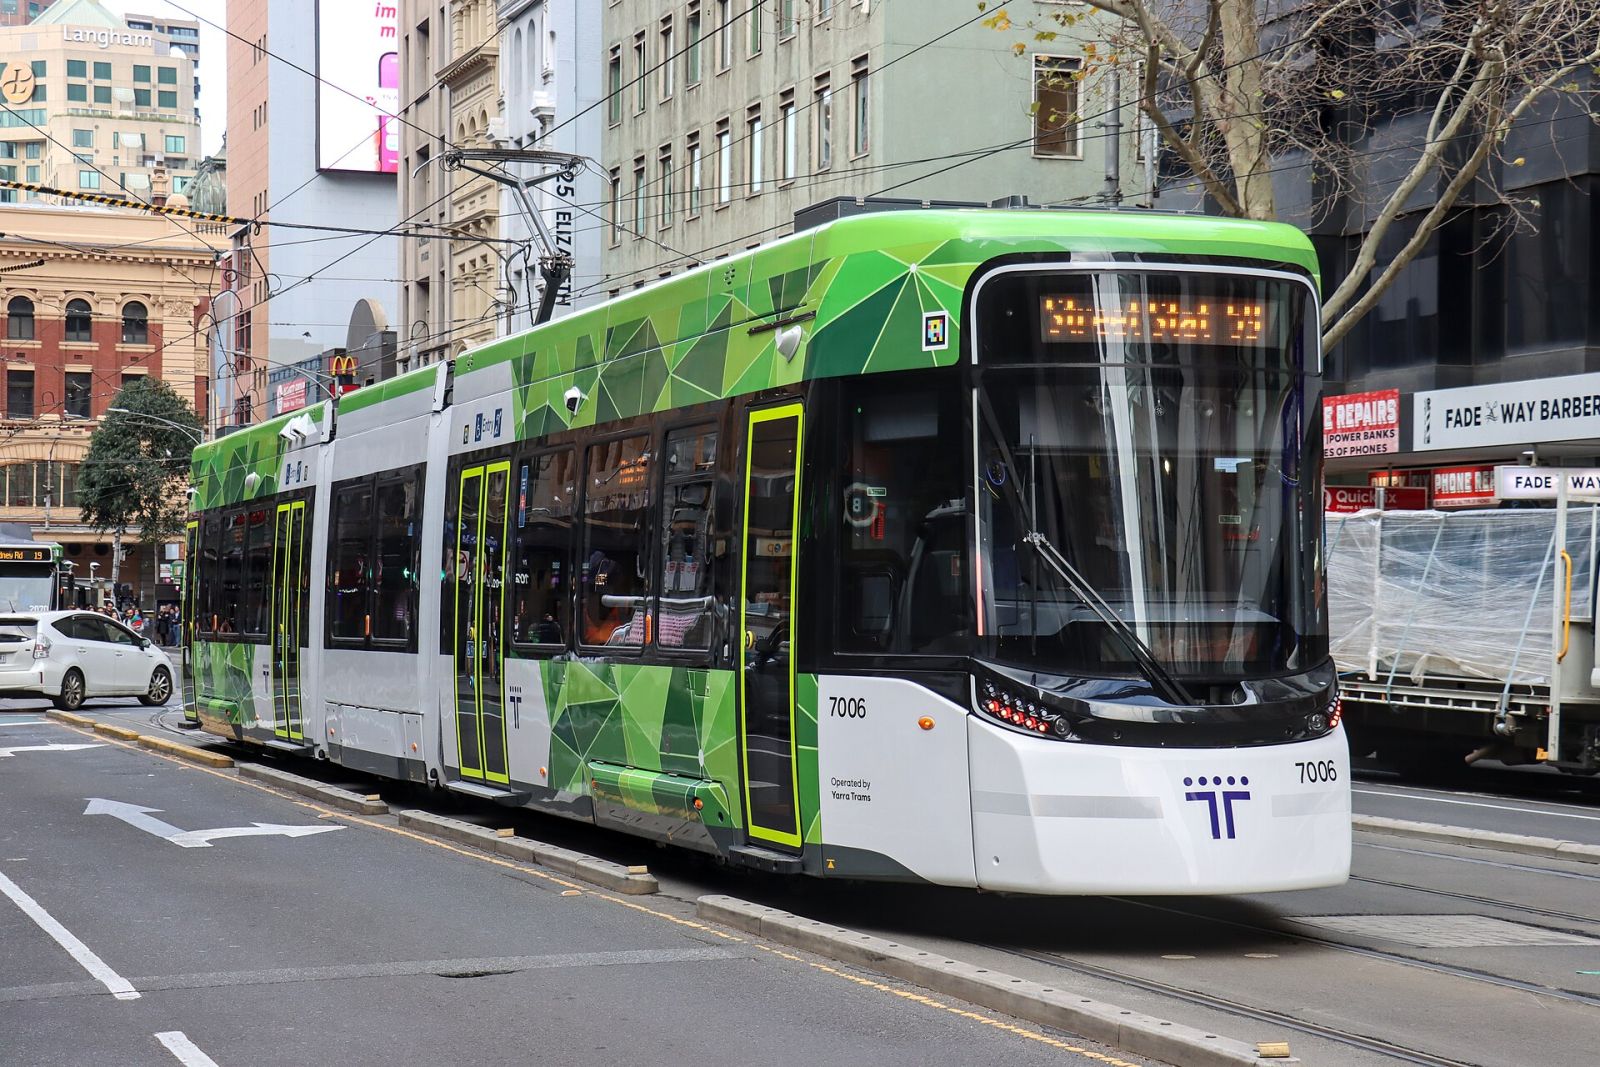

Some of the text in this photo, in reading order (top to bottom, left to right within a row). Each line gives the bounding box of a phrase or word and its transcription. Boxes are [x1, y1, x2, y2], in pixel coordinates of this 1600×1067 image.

[63, 25, 152, 49] Langham
[1336, 399, 1396, 429] REPAIRS
[1445, 394, 1600, 429] FADE WAY BARBER
[1329, 429, 1395, 443] POWER BANKS
[1336, 447, 1348, 455] OF
[1350, 444, 1387, 455] PHONES
[1434, 471, 1472, 495] PHONE
[1515, 476, 1552, 488] FADE
[14, 551, 23, 560] Rd
[34, 551, 43, 560] 19
[829, 696, 866, 718] 7006
[1295, 760, 1337, 784] 7006
[830, 777, 871, 790] Operated by
[831, 791, 871, 801] Yarra Trams
